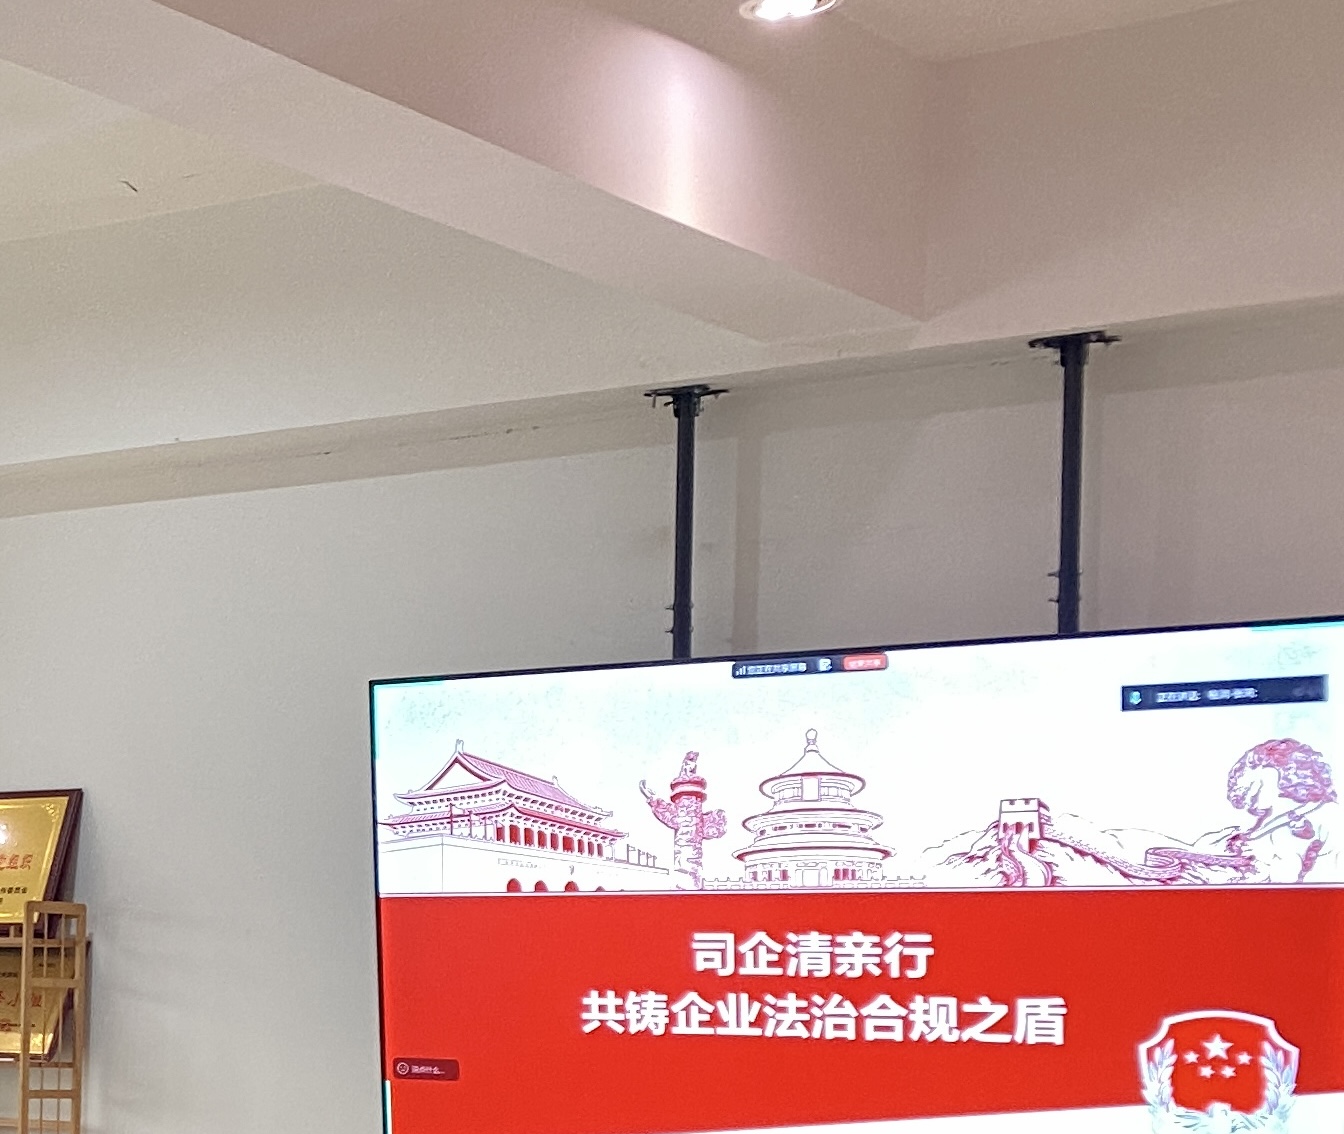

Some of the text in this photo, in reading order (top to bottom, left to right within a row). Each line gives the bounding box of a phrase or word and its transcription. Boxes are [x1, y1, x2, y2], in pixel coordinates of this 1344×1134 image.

[691, 931, 935, 978] 司企清亲行
[581, 990, 1068, 1046] 共铸企业法治合规之盾
